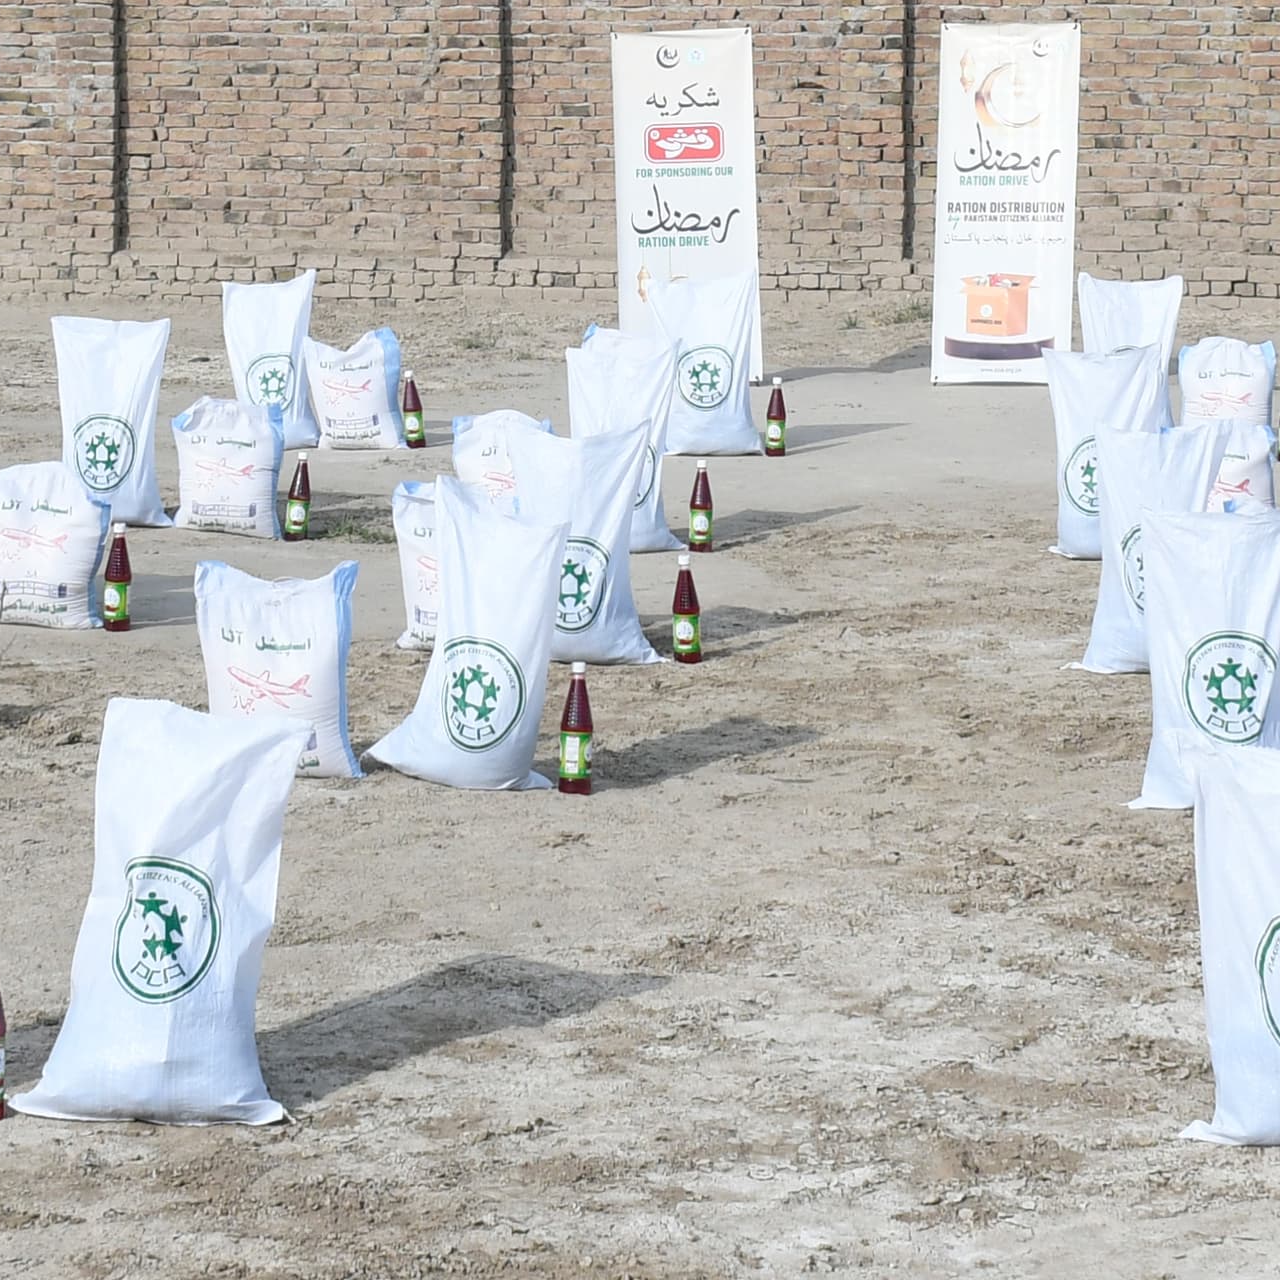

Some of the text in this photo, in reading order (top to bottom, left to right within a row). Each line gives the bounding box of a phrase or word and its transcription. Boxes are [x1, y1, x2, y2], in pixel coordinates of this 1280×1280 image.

[954, 122, 1061, 183] رمضان
[636, 166, 733, 178] FOR SPONSORING OUR
[959, 175, 1029, 186] RATION DRIVE
[631, 184, 740, 243] رمضان
[947, 202, 1065, 213] RATION DISTRIBUTION
[638, 235, 710, 248] RATION DRIVE
[83, 469, 121, 485] PCA
[450, 712, 496, 740] PCA
[1206, 714, 1261, 734] PCA
[130, 960, 186, 987] PCA
